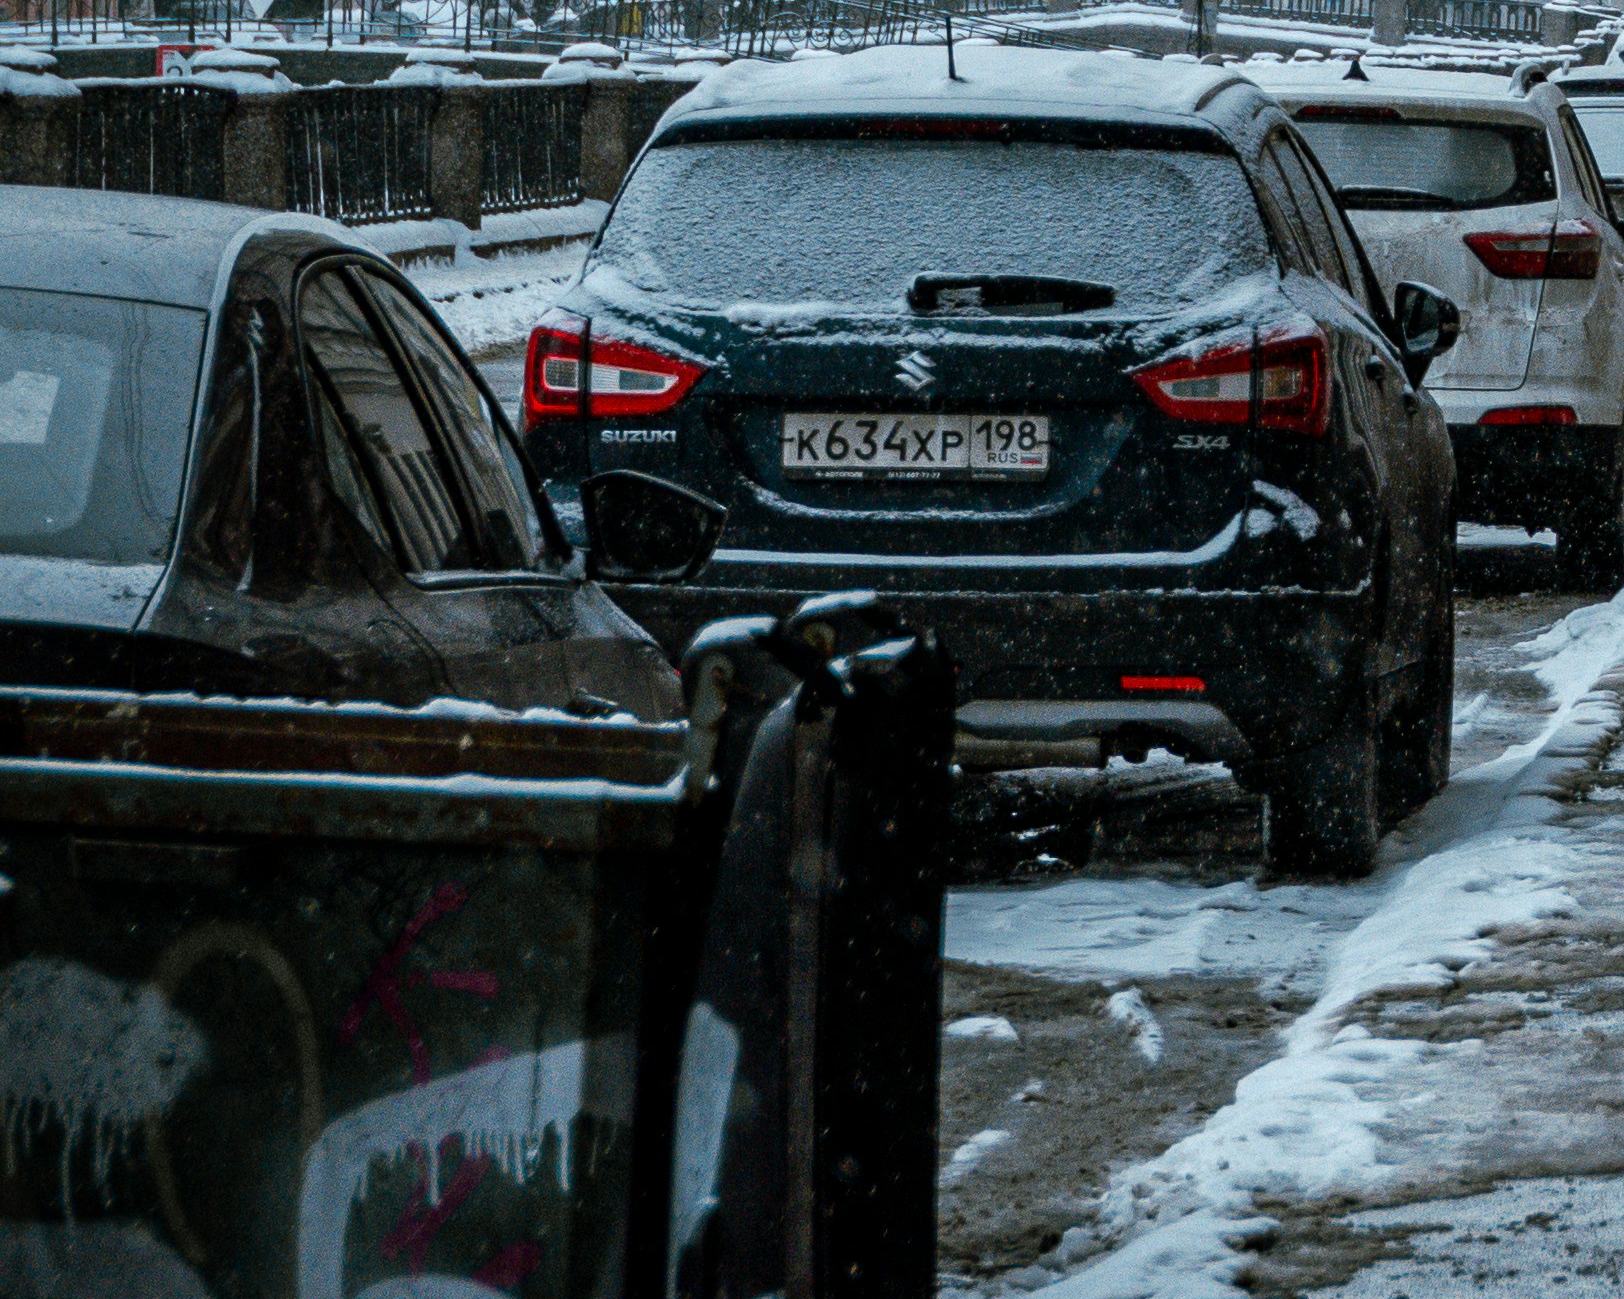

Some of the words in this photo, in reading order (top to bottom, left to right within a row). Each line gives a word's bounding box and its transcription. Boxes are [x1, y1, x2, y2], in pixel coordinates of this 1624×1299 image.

[601, 429, 677, 443] SUZUKI
[797, 419, 964, 462] К634ХР
[975, 419, 1037, 451] 198
[1172, 435, 1231, 449] SX4
[987, 452, 1018, 464] RUS
